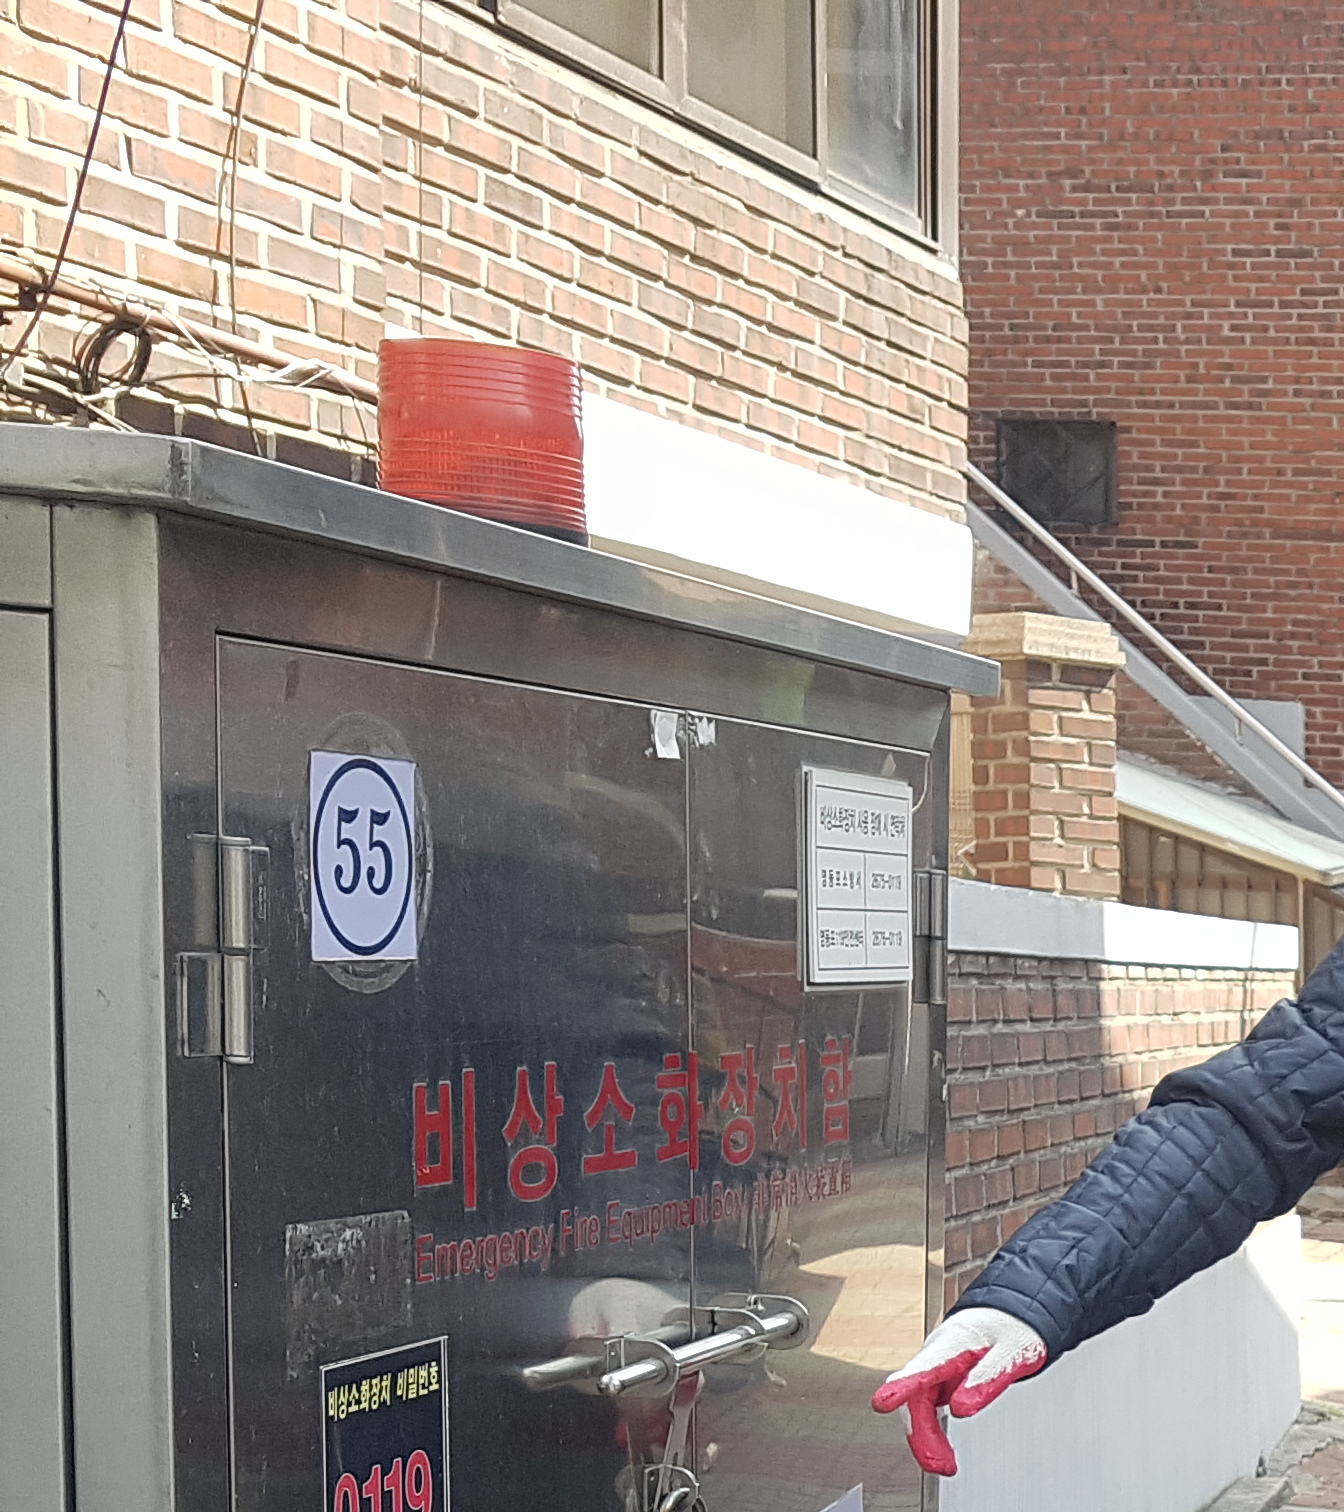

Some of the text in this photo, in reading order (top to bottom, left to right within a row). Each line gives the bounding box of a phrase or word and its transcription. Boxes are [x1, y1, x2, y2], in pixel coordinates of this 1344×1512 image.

[334, 805, 393, 895] 55
[414, 1220, 554, 1285] Emergency
[557, 1209, 600, 1257] Fire
[327, 1361, 441, 1422] 비상소화장치 비밀번호
